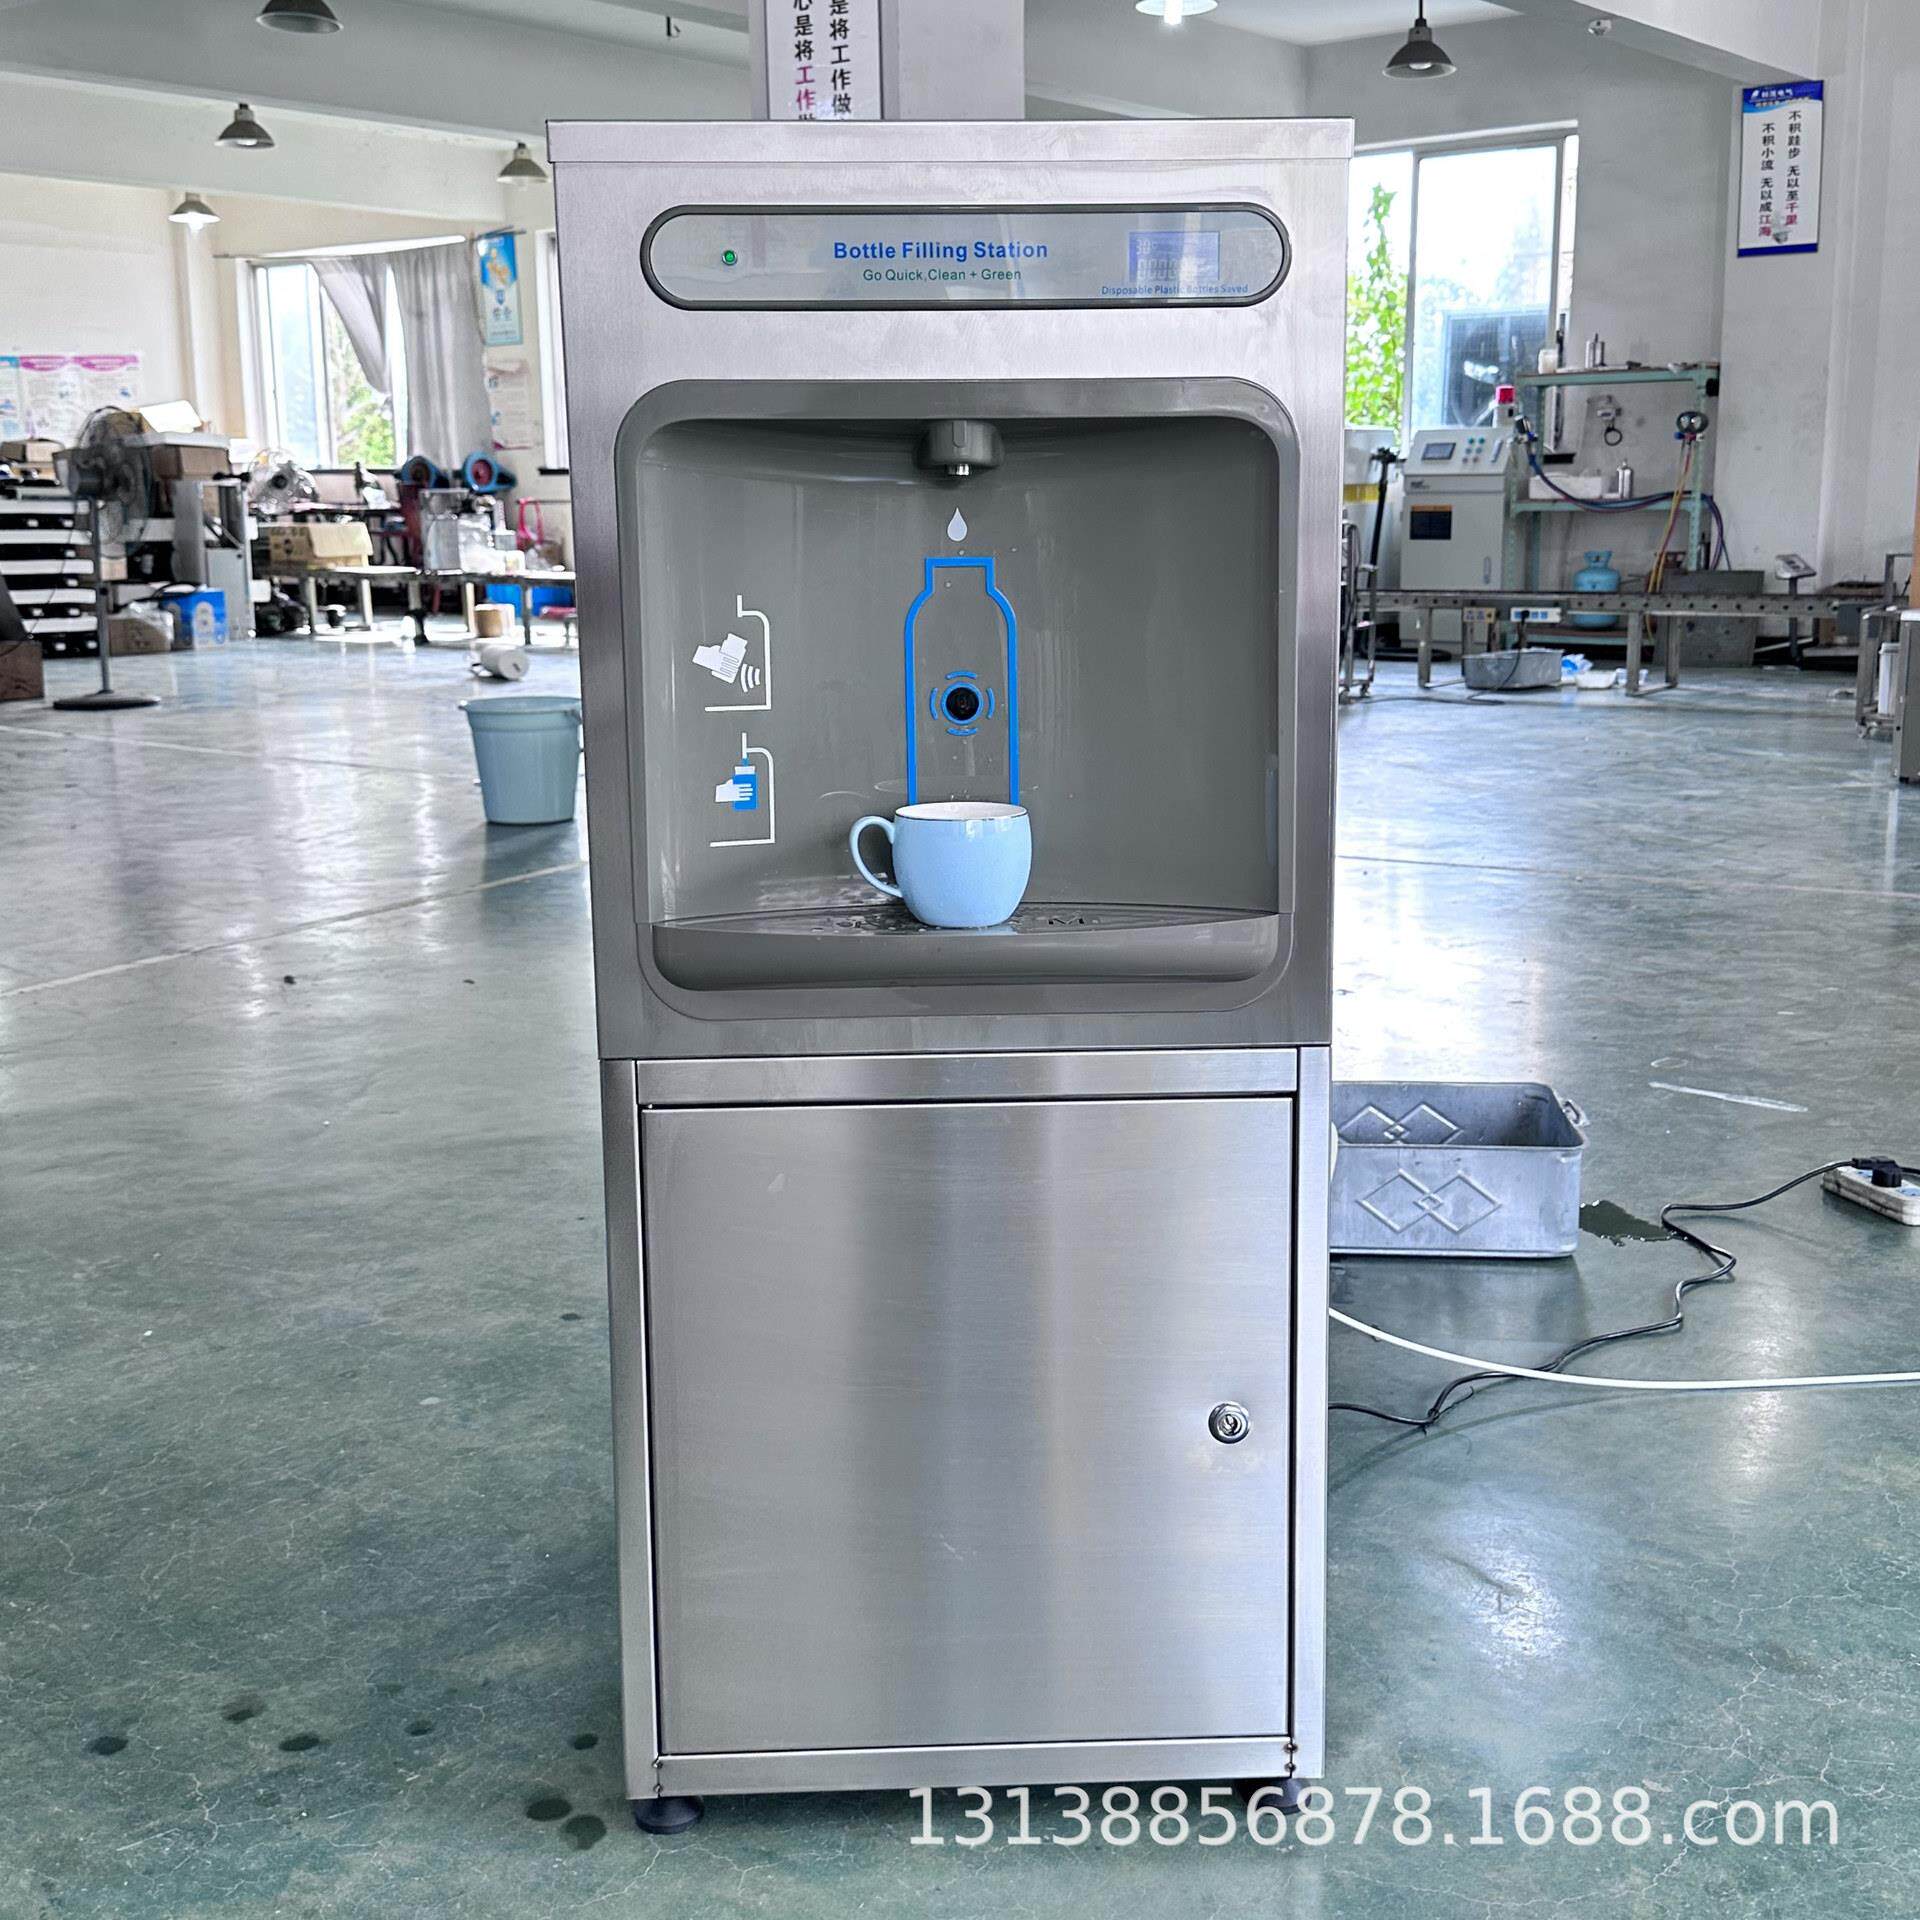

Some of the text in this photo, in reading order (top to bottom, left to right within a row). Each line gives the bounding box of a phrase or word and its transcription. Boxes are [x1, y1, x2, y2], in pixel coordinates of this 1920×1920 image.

[793, 0, 816, 120] 心是将工作
[1759, 123, 1775, 237] 不积小流 无以成江海
[834, 241, 1048, 262] Bottle Filling Station
[863, 269, 882, 281] Go
[981, 268, 1021, 281] Green
[1101, 285, 1152, 296] Disposable
